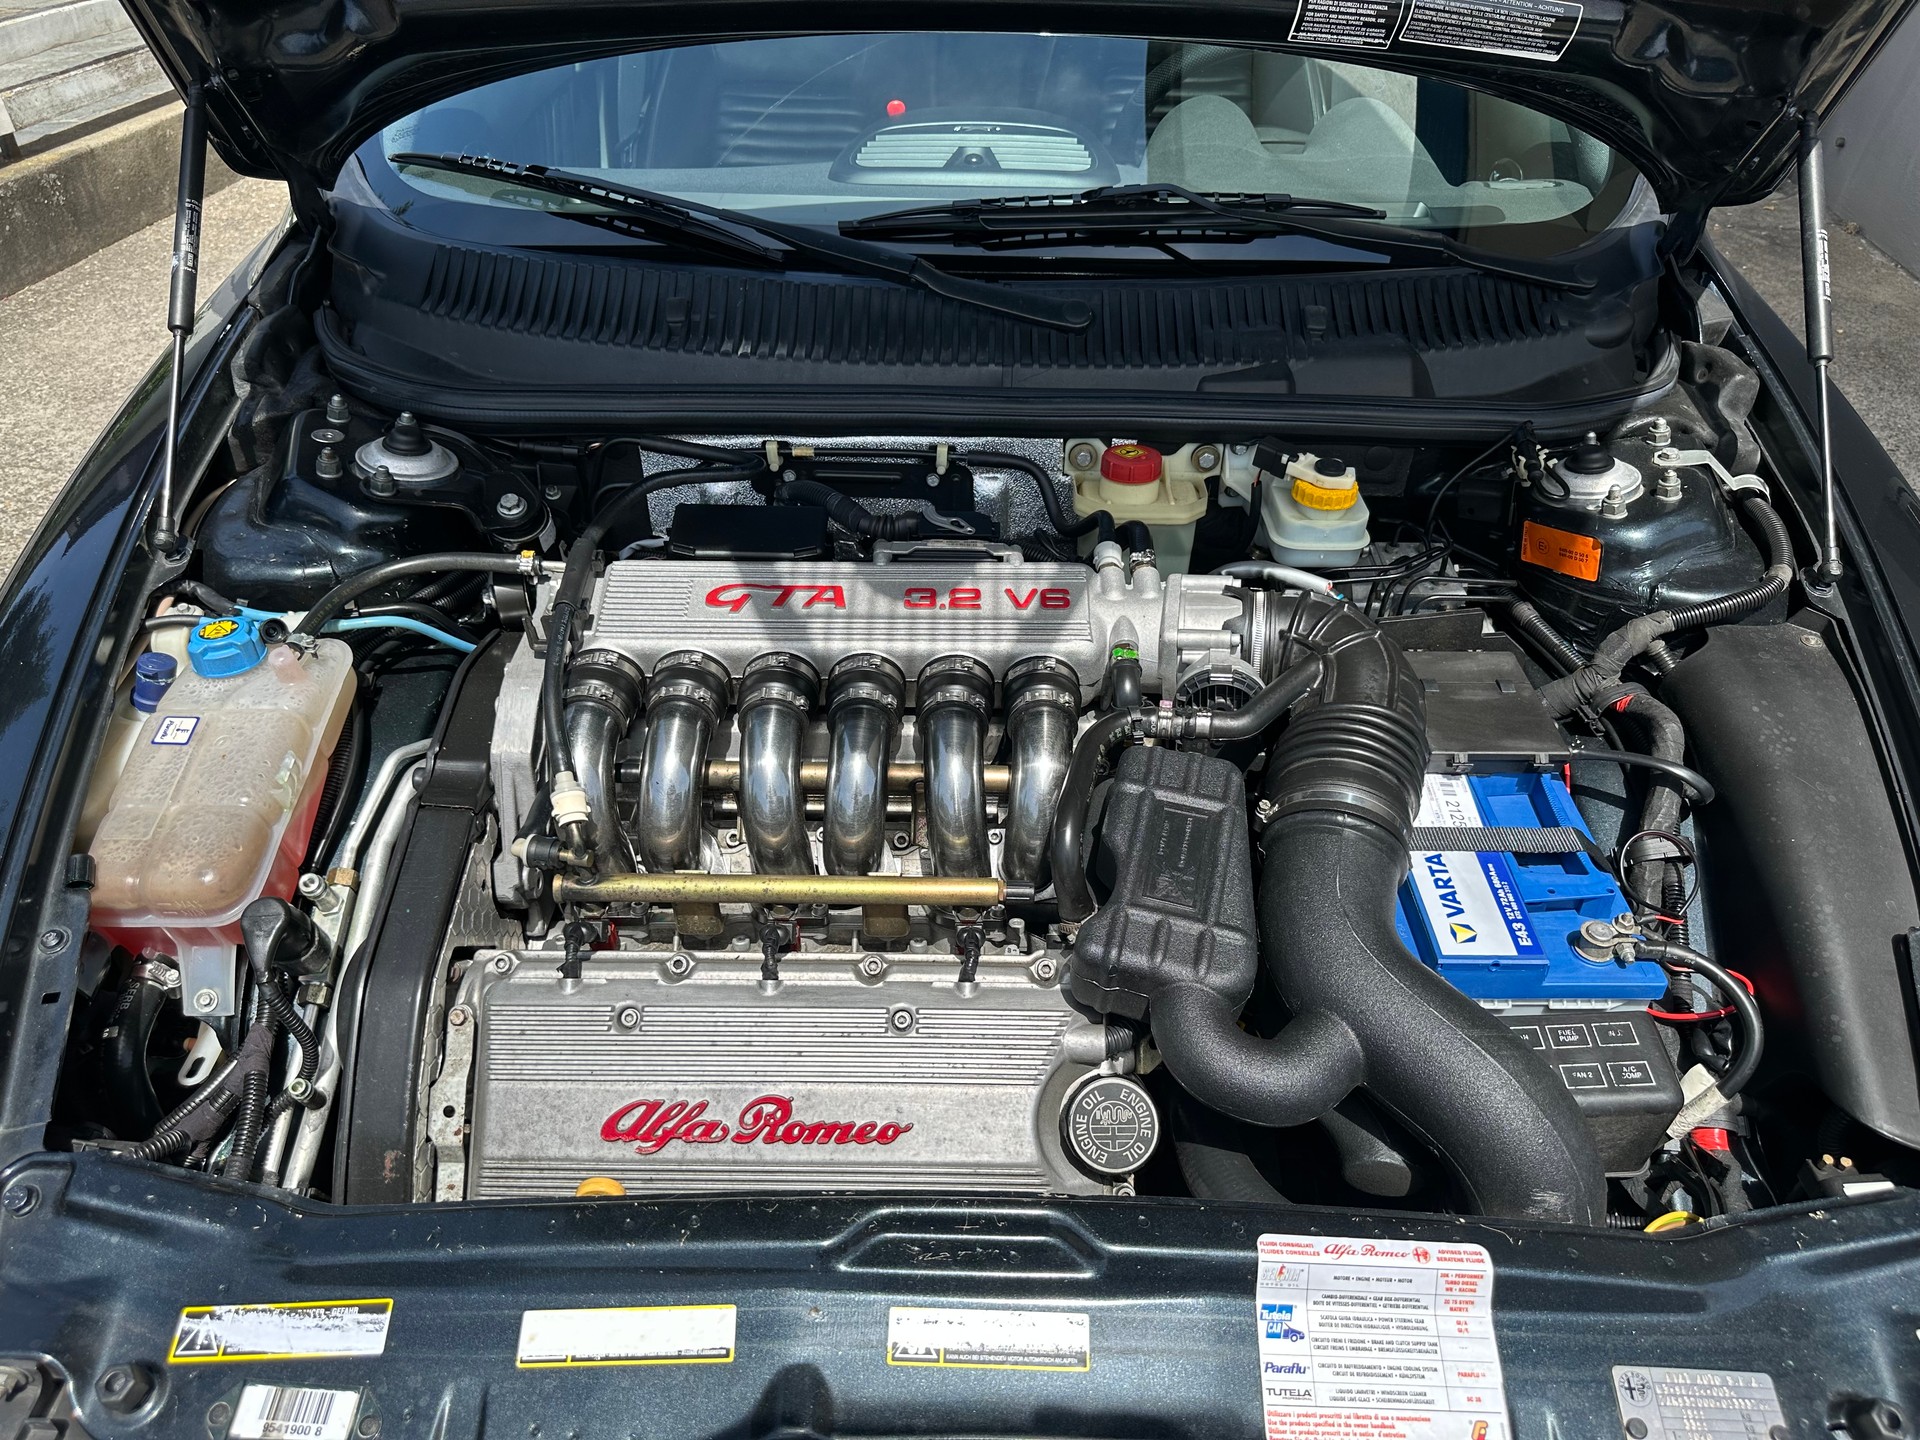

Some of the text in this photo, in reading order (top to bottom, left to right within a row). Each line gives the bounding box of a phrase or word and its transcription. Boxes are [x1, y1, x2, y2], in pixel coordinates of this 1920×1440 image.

[1538, 5, 1565, 13] ACHTUNG
[705, 583, 1071, 614] GTA 3.2 V6
[1424, 853, 1465, 918] VARTA
[1503, 907, 1516, 920] 12V
[1512, 922, 1533, 946] E43
[1558, 1028, 1577, 1036] FUEL
[600, 1094, 914, 1155] Alfa Romeo
[1076, 1090, 1108, 1164] ENGINE OIL
[1120, 1088, 1152, 1163] ENGINE OIL
[1324, 1244, 1360, 1260] Alfa
[1360, 1244, 1410, 1258] Romeo
[332, 1307, 359, 1315] GEFAHR
[1262, 1310, 1291, 1322] Tutela
[1267, 1322, 1281, 1333] CAR
[1264, 1362, 1307, 1375] Paraflu
[1266, 1388, 1312, 1397] TUTELA
[1267, 1409, 1292, 1418] Utilizzare
[1297, 1411, 1317, 1419] prodotti
[1319, 1412, 1342, 1420] prescritti
[262, 1422, 323, 1436] 9541900 8
[1313, 1420, 1335, 1428] specified
